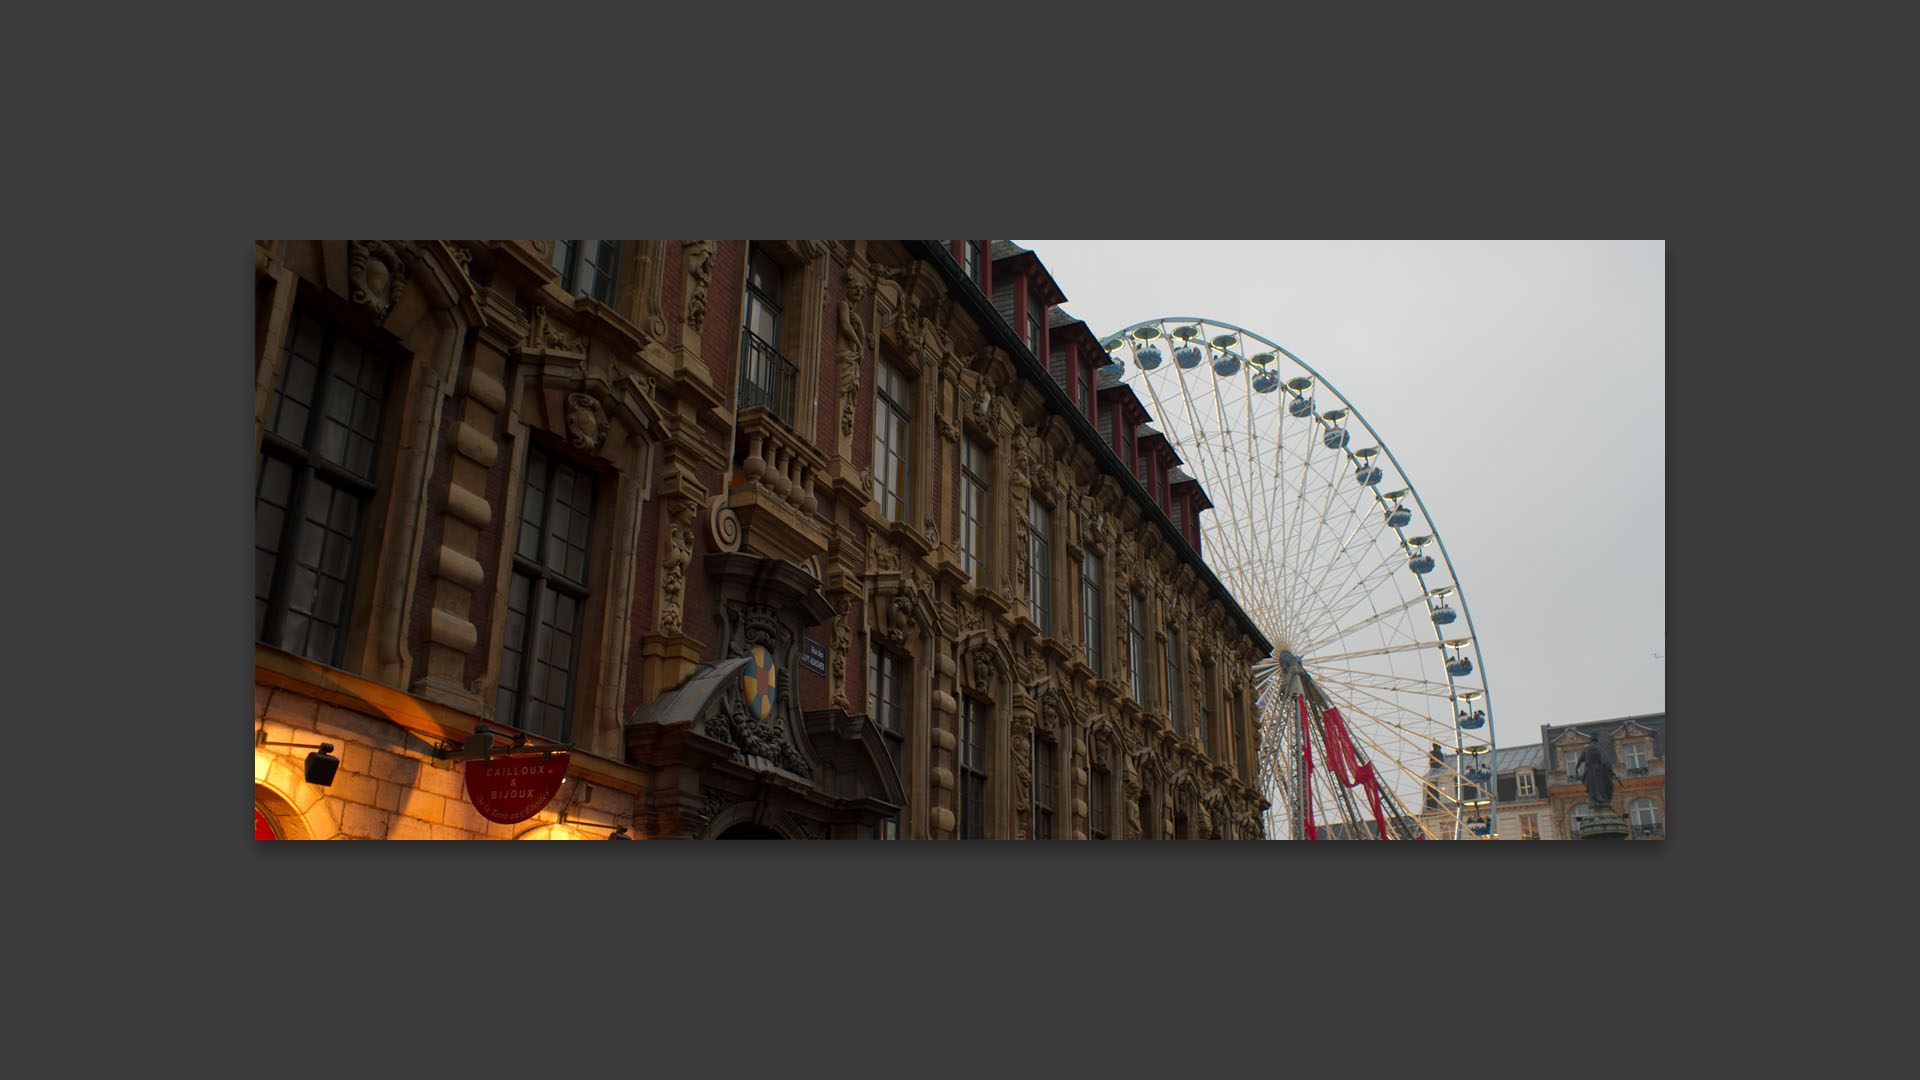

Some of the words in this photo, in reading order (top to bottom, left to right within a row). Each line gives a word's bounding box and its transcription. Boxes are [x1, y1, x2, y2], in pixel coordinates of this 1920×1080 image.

[486, 765, 545, 777] CAILLOUX
[510, 778, 517, 787] &
[490, 789, 534, 800] BIJOUX
